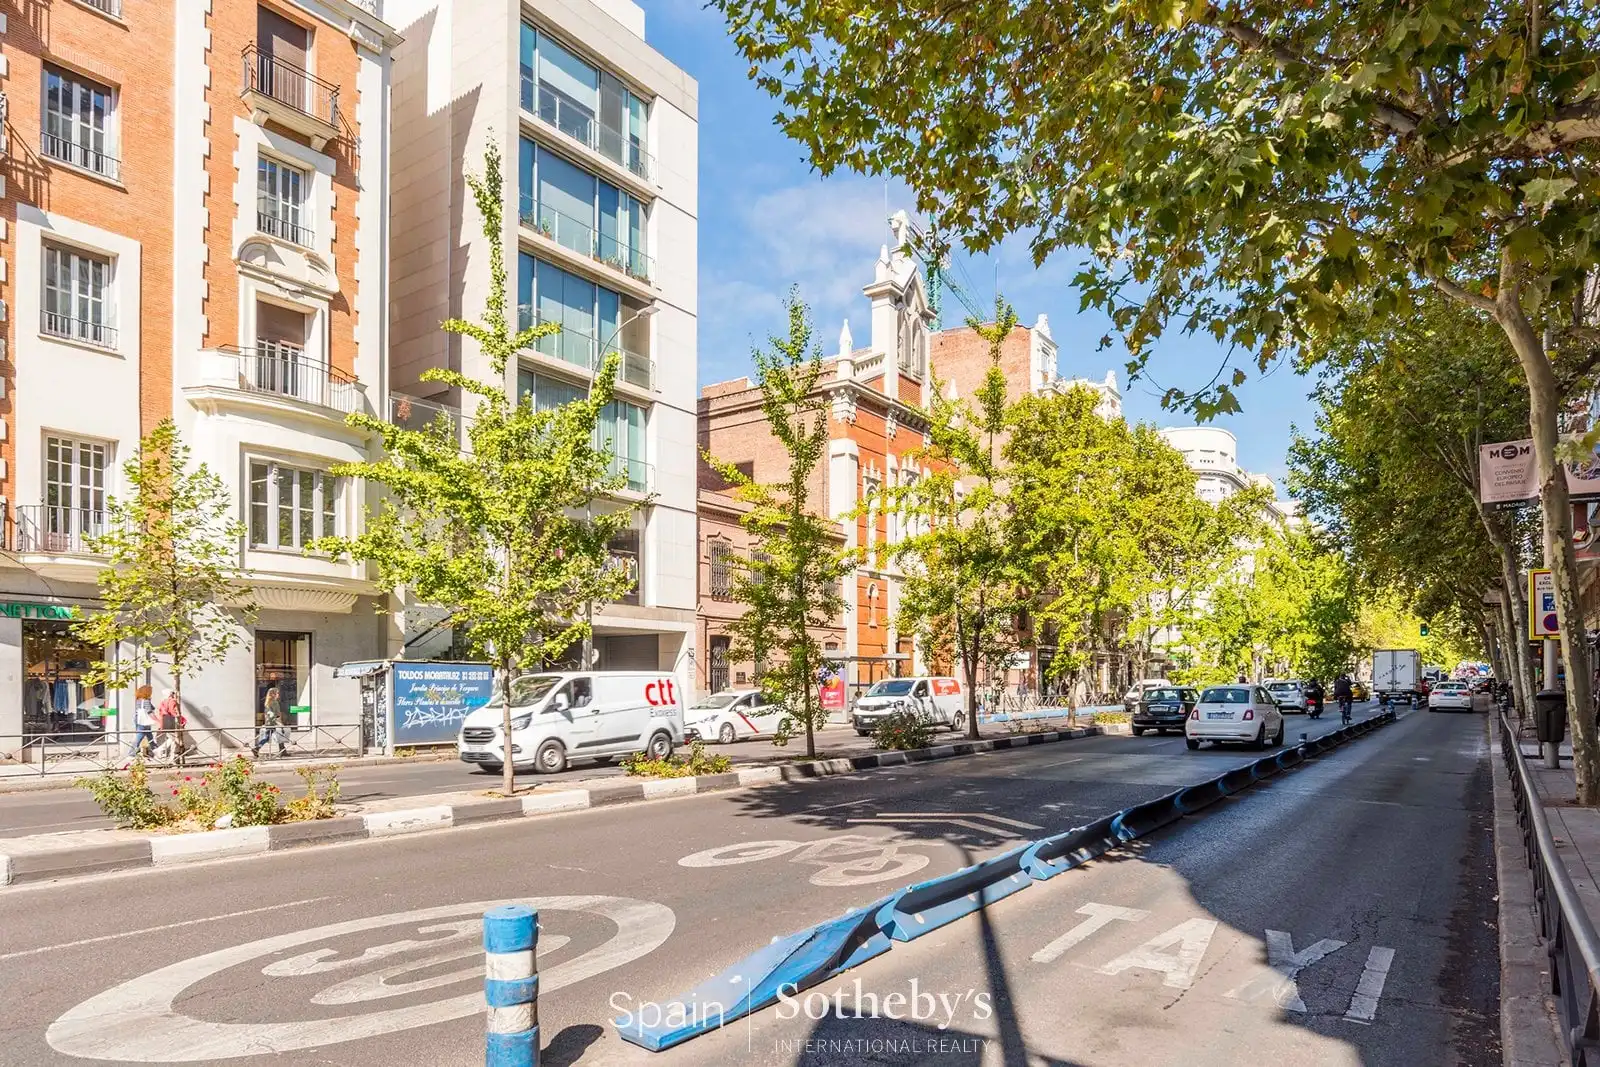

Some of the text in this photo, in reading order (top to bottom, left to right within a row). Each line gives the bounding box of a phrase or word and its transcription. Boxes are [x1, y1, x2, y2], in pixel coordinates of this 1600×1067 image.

[1502, 501, 1526, 509] MADRID
[397, 670, 424, 680] TOLDOS
[645, 679, 676, 706] ctt
[1031, 902, 1396, 1025] TAXI
